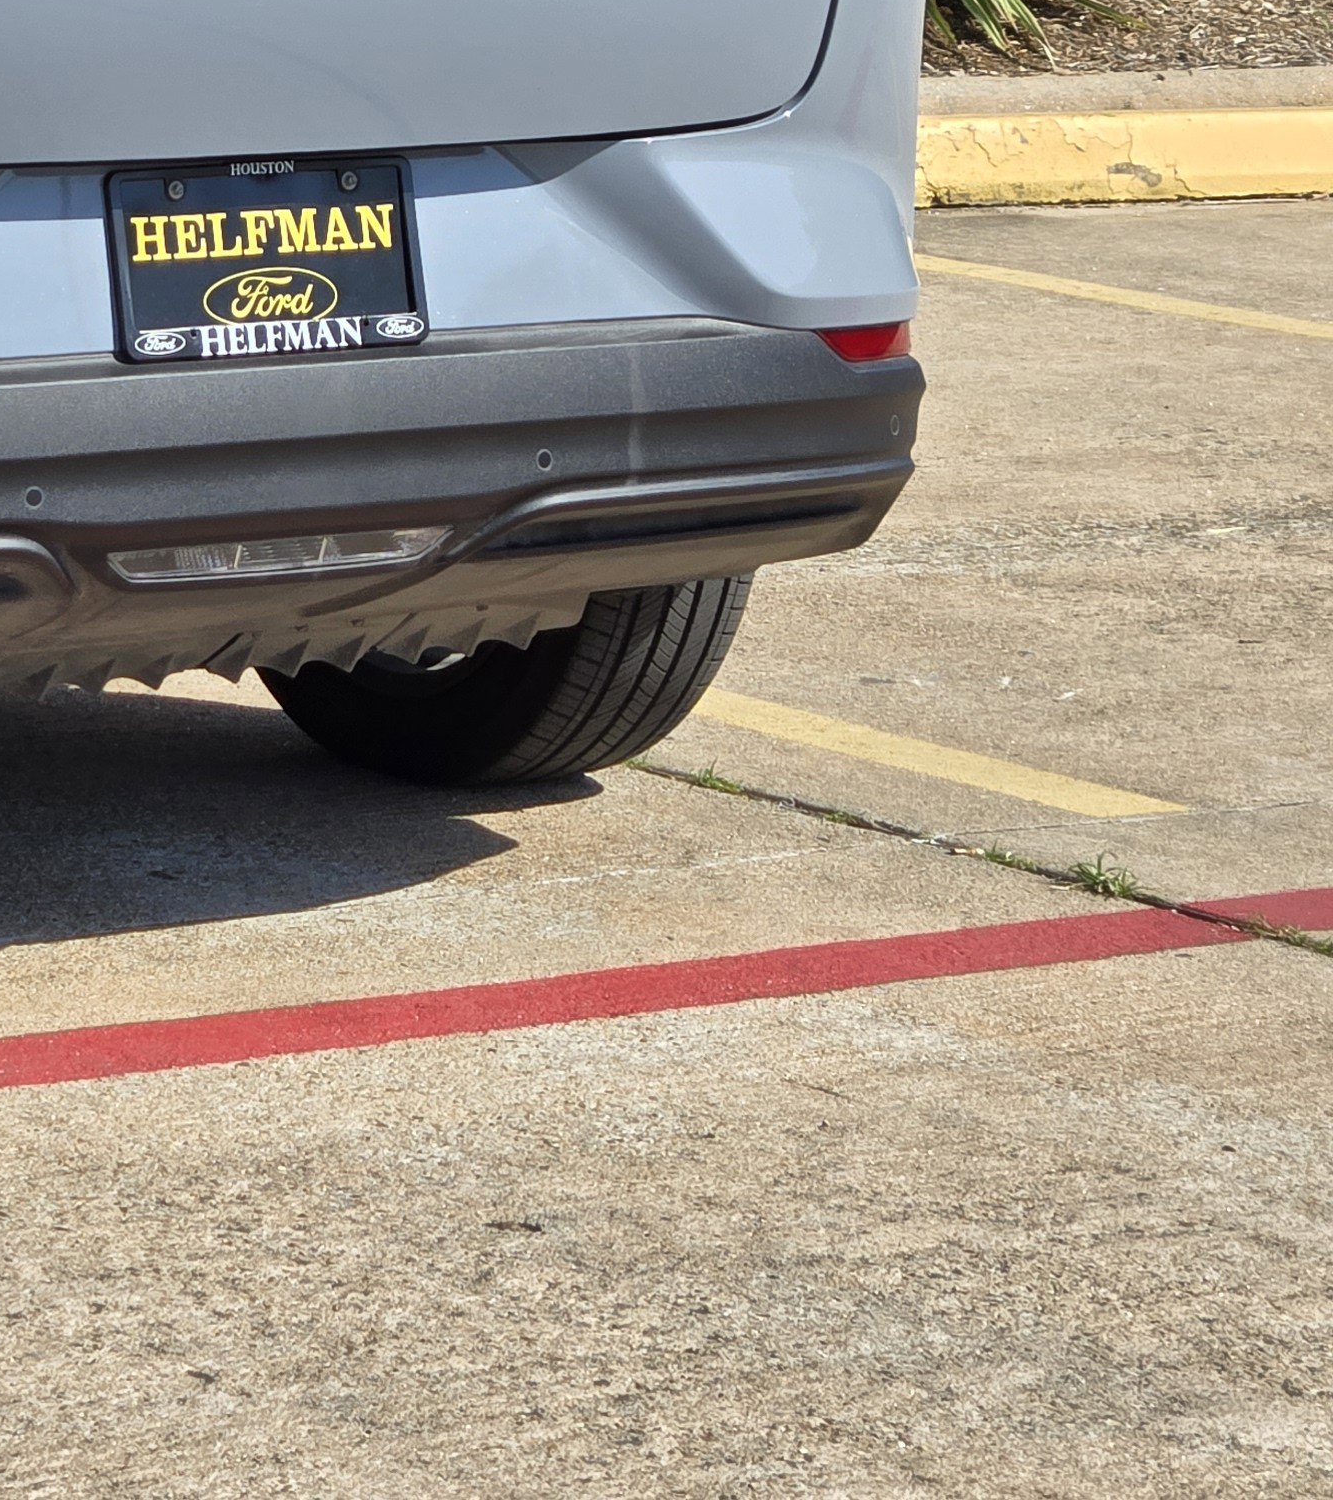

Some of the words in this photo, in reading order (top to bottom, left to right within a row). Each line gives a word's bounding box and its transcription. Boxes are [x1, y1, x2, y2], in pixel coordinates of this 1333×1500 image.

[230, 160, 295, 177] HOUSTON
[130, 203, 394, 263] HELFMAN
[230, 275, 315, 319] Ford
[143, 335, 178, 352] Ford
[197, 315, 365, 357] HELFMAN
[383, 317, 418, 334] Ford
